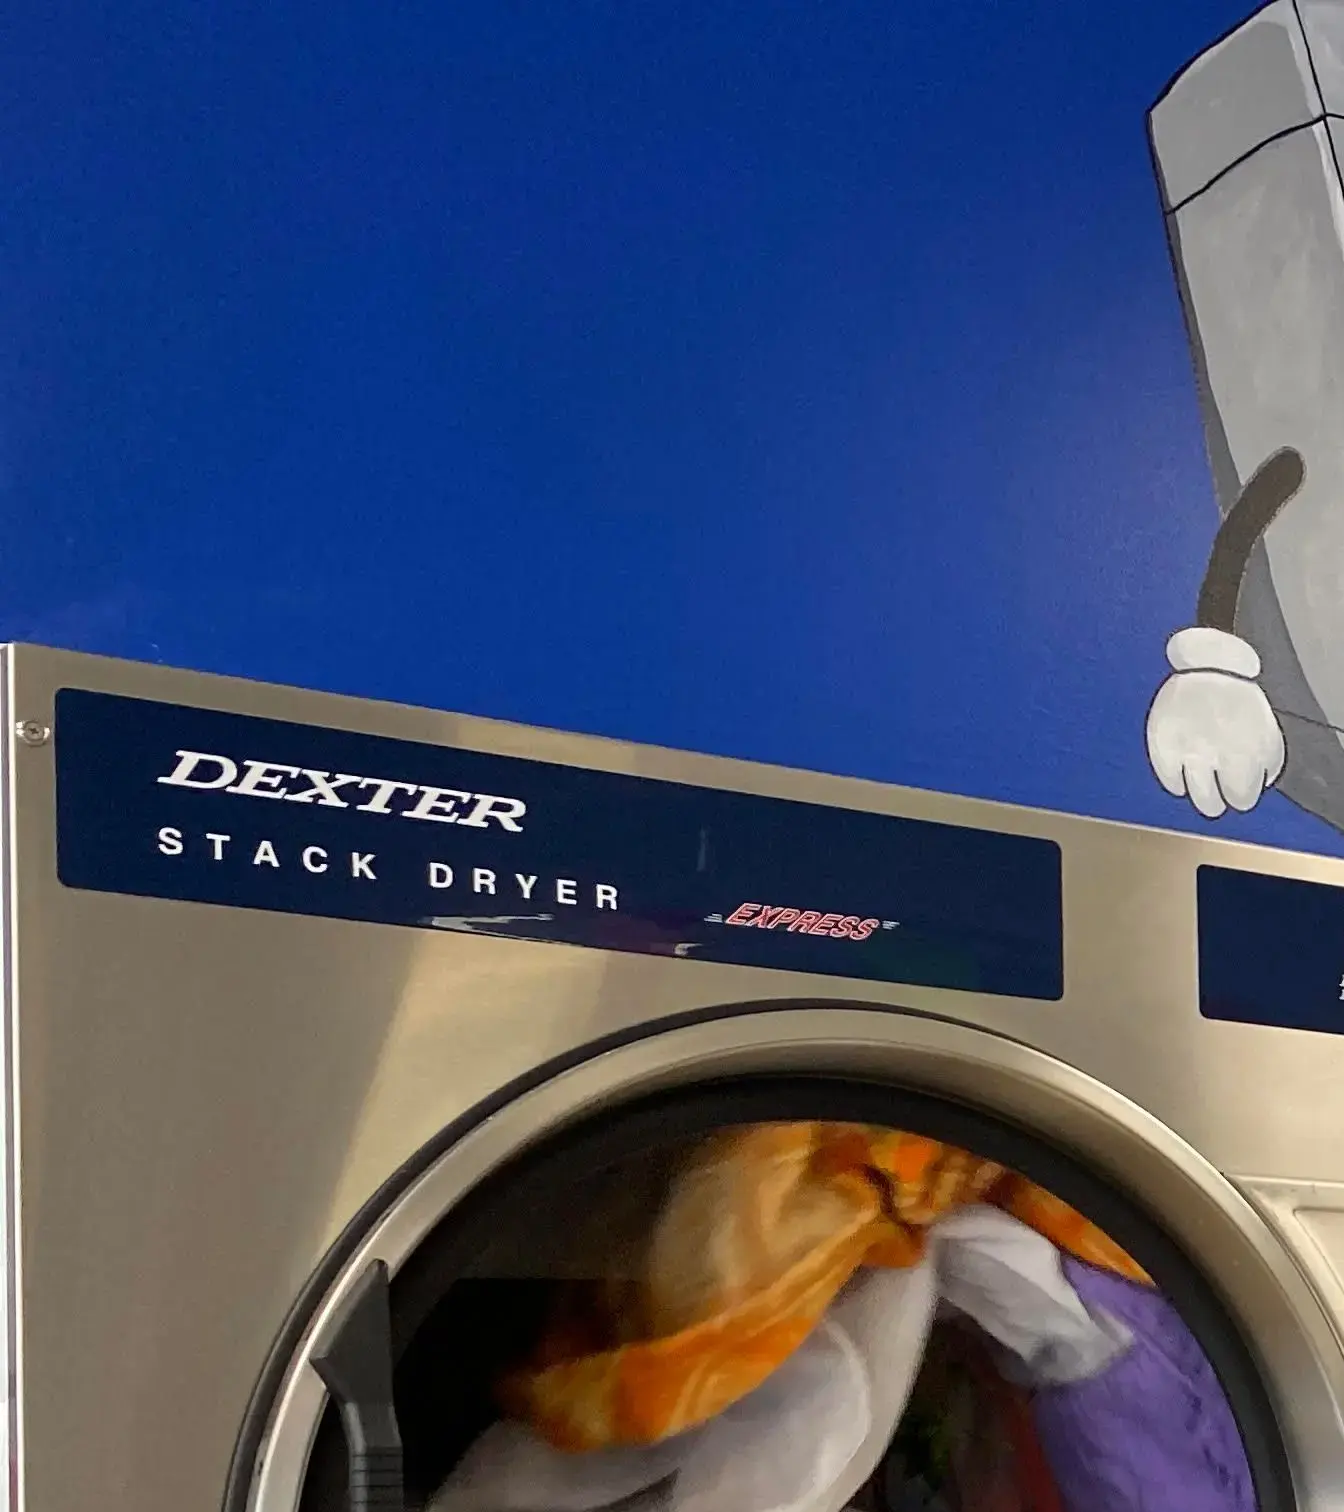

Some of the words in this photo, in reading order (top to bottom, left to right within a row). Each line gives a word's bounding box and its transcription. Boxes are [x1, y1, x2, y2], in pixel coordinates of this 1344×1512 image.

[158, 749, 528, 835] DEXTER
[157, 827, 379, 881] STACK
[429, 862, 621, 913] DRYER
[724, 902, 882, 943] EXPRESS
